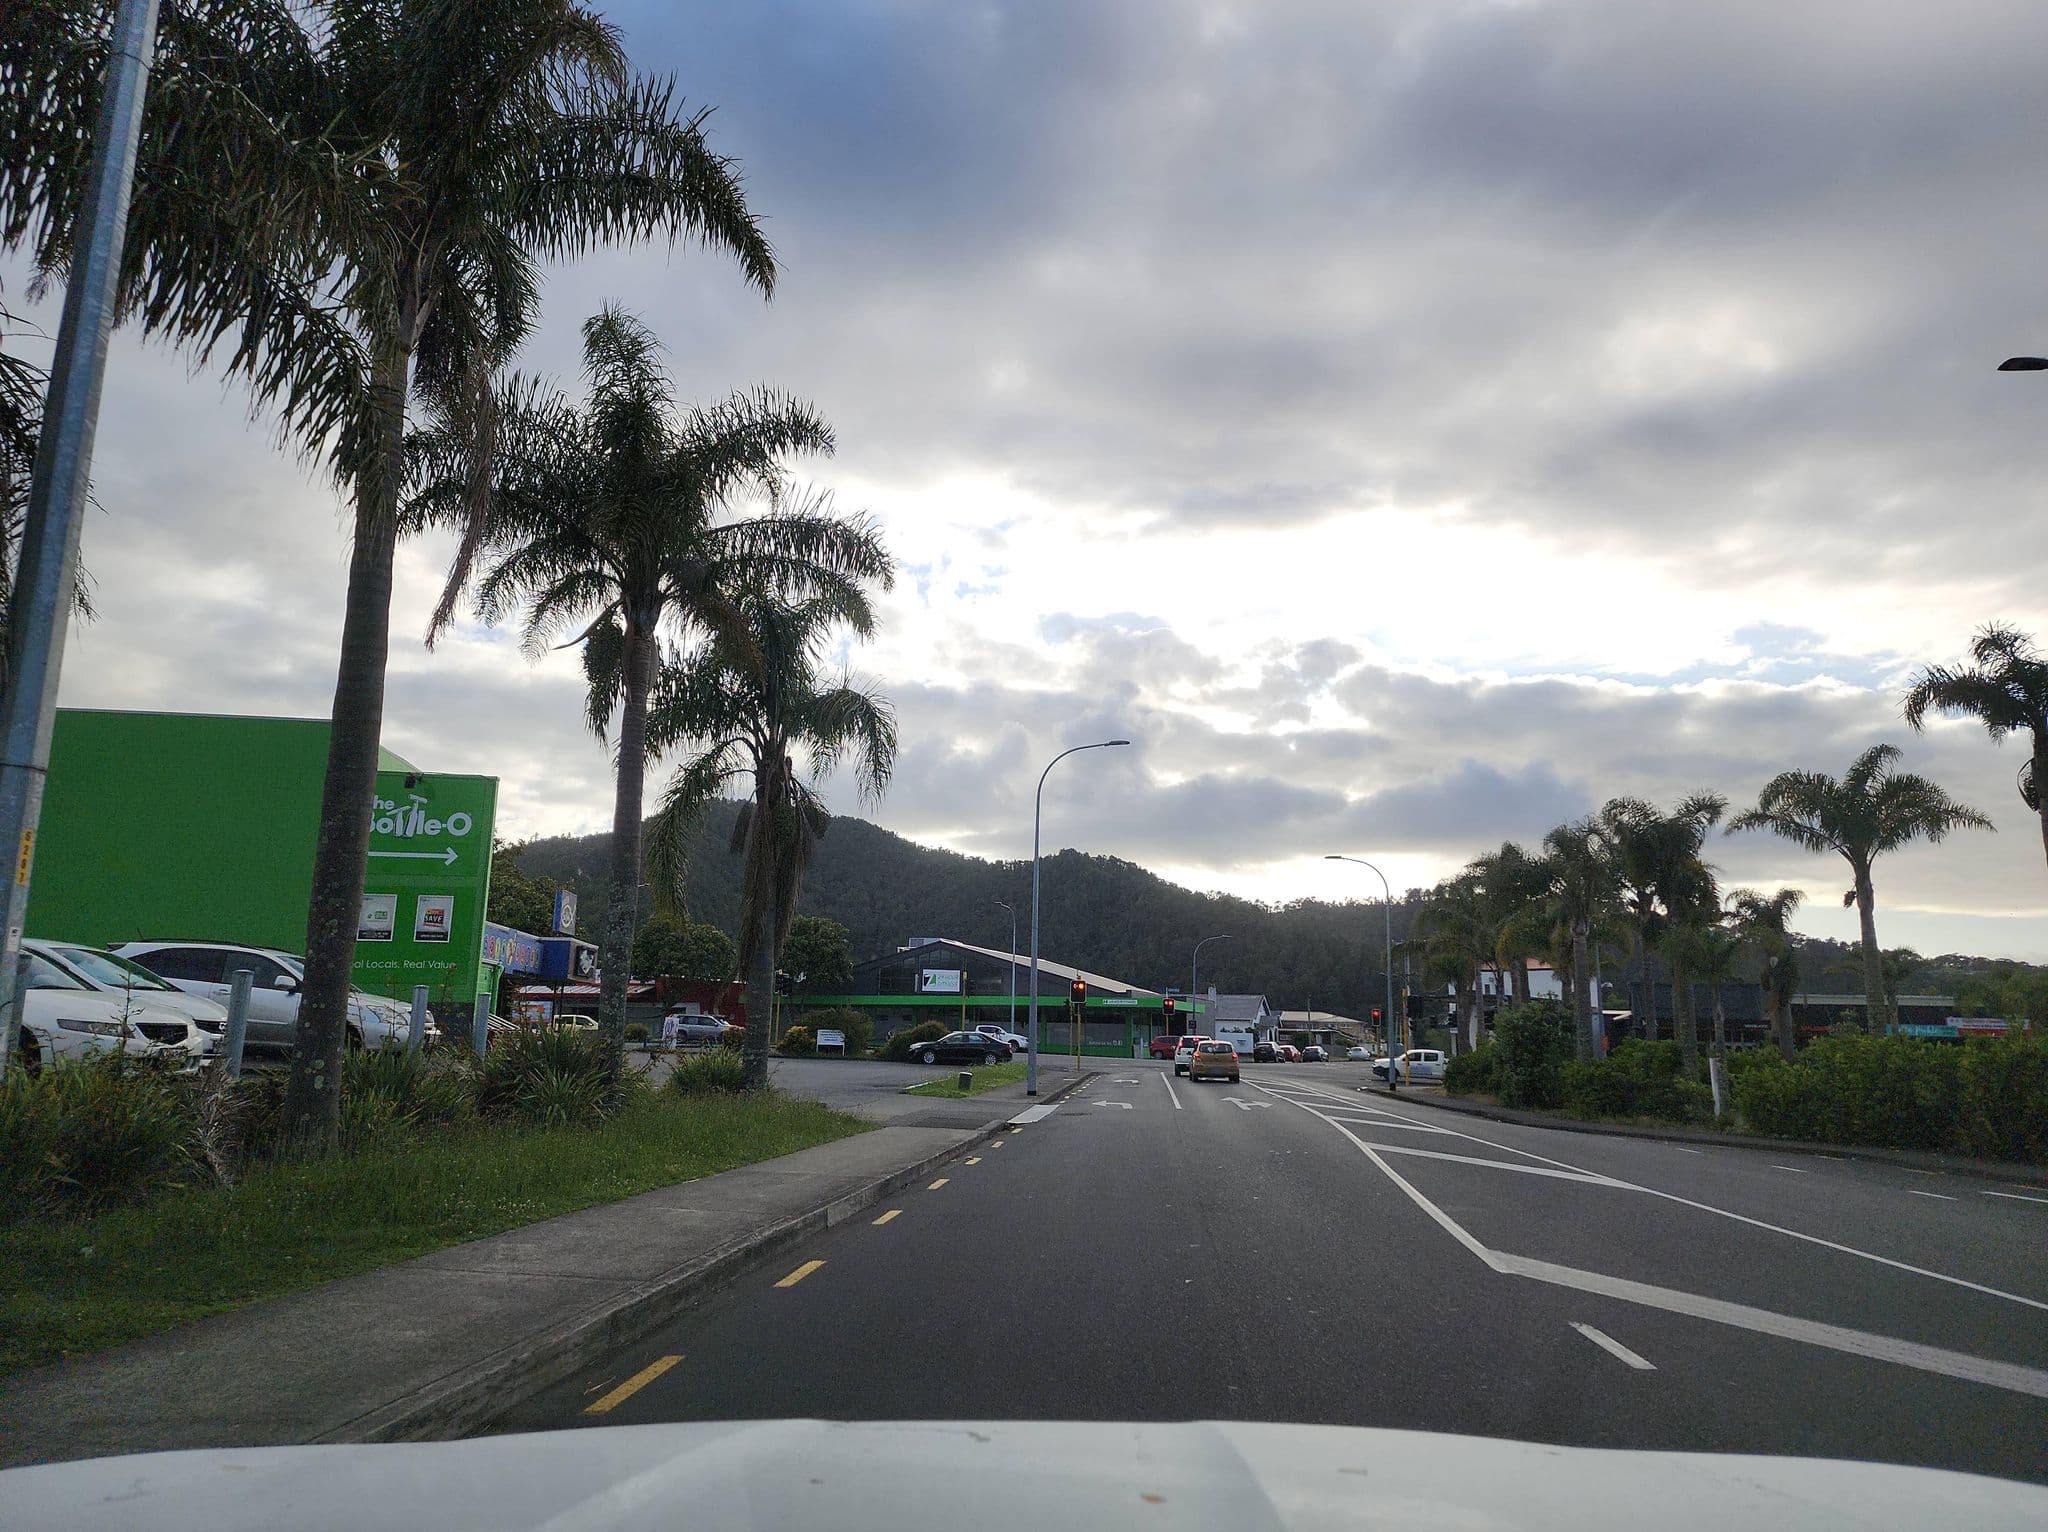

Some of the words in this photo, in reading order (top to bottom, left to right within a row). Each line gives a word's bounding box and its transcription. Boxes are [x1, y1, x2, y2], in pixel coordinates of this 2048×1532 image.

[372, 794, 395, 810] he
[423, 914, 444, 923] SAVE
[403, 960, 426, 969] Real
